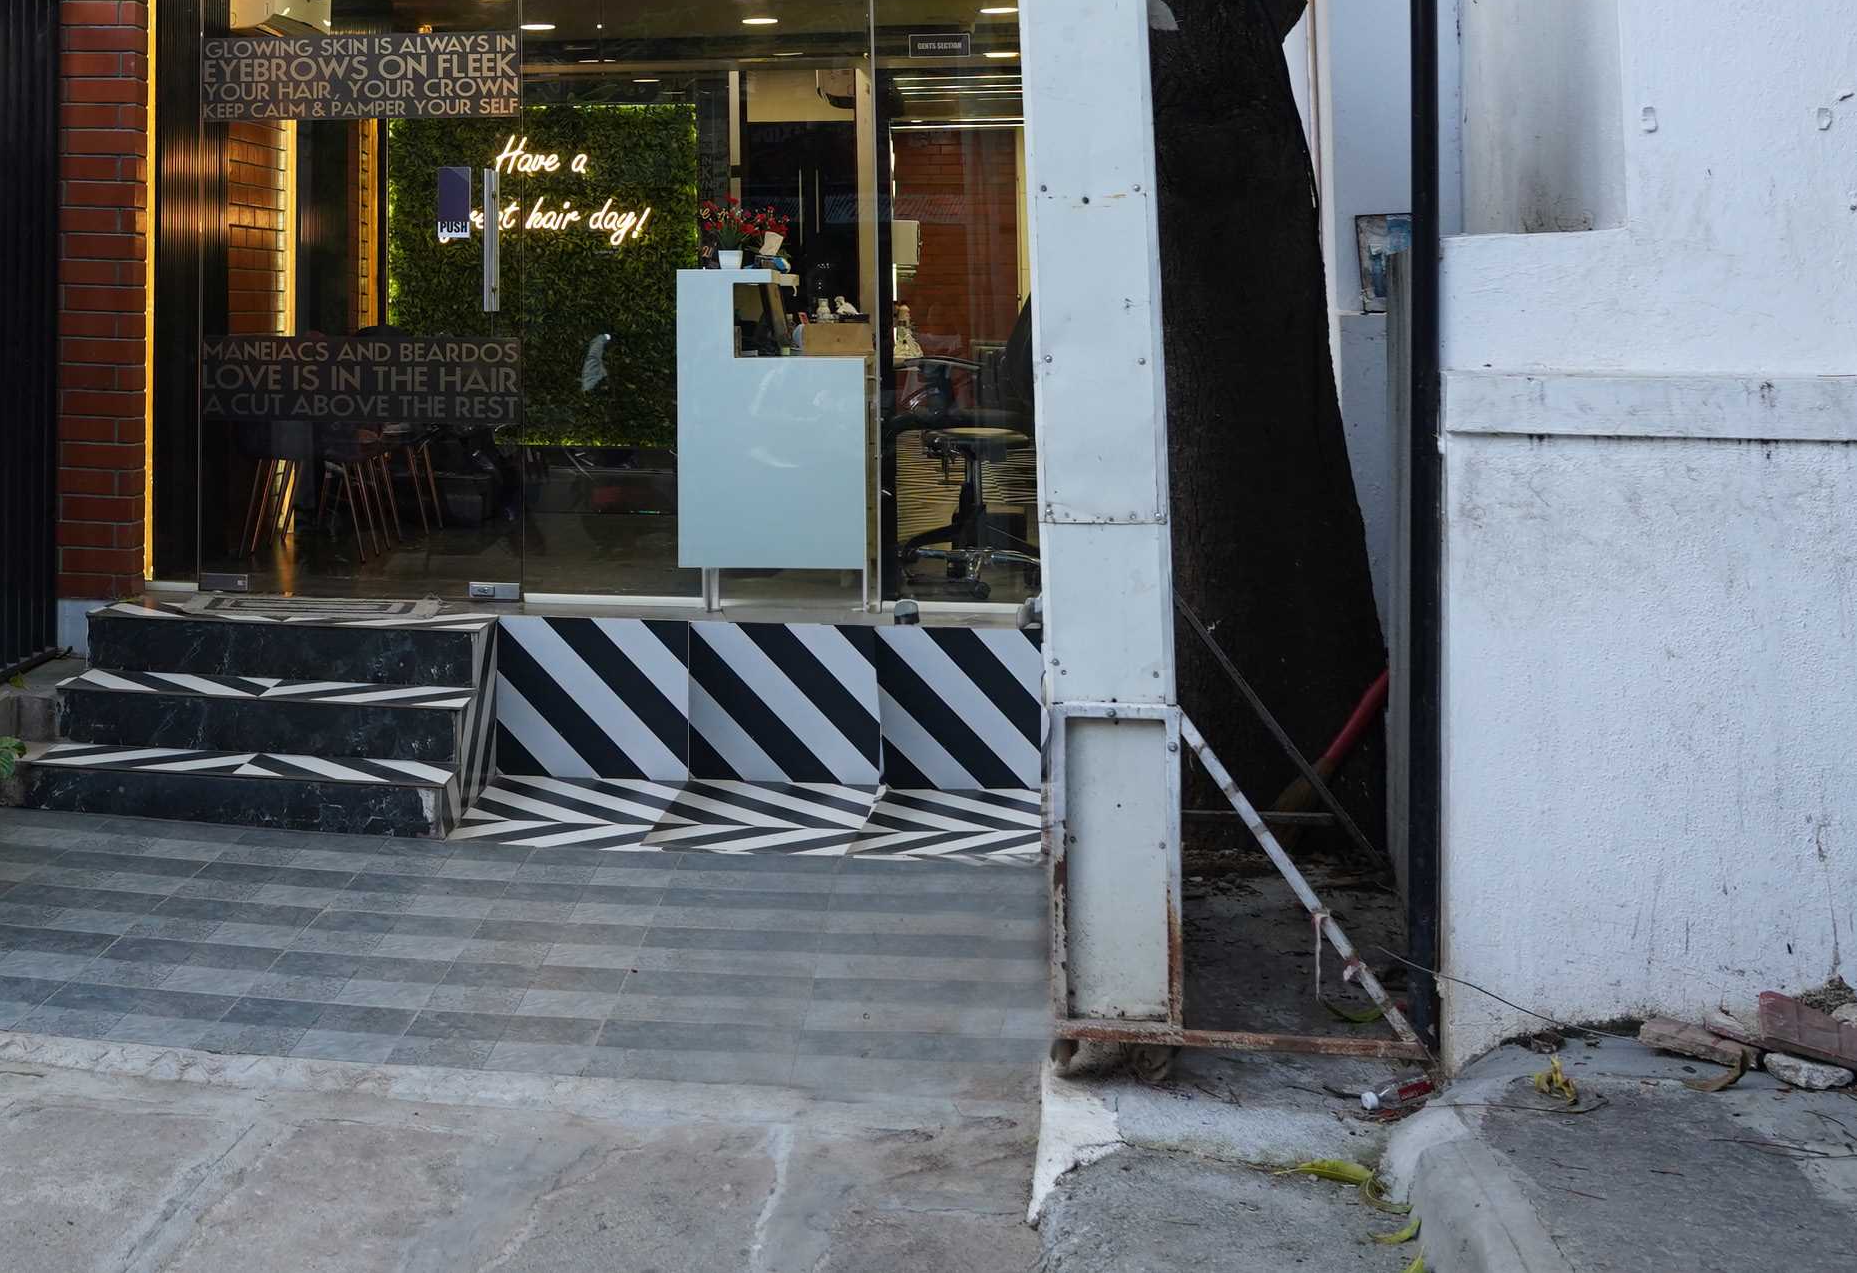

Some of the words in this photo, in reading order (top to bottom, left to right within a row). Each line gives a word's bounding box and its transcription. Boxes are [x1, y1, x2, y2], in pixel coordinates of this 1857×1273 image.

[206, 40, 312, 59] GLOWING
[320, 38, 368, 56] SKIN
[375, 37, 392, 55] IS
[399, 35, 489, 54] ALWAYS
[496, 34, 517, 54] IN
[203, 55, 368, 83] EYEBROWS
[378, 54, 427, 79] ON
[437, 52, 517, 78] FLEEK
[203, 82, 271, 101] YOUR
[278, 81, 341, 101] HAIR,
[348, 79, 415, 99] YOUR
[423, 78, 519, 98] CROWN
[203, 102, 243, 119] KEEP
[251, 101, 306, 118] CALM
[312, 101, 326, 117] &
[332, 99, 406, 117] PAMPER
[414, 99, 471, 116] YOUR
[479, 97, 519, 114] SELF
[495, 134, 561, 174] Have
[571, 153, 587, 174] a
[439, 221, 468, 234] PUSH
[525, 196, 581, 230] hair
[589, 197, 652, 246] day!
[203, 342, 328, 361] MANEIACS
[336, 342, 391, 362] AND
[399, 342, 519, 363] BEARDOS
[202, 364, 282, 391] LOVE
[292, 365, 319, 391] IS
[331, 365, 361, 391] IN
[373, 366, 428, 392] THE
[439, 366, 519, 393] HAIR
[203, 394, 224, 415] A
[230, 394, 285, 416] CUT
[291, 394, 390, 417] ABOVE
[398, 396, 446, 418] THE
[455, 396, 519, 419] REST
